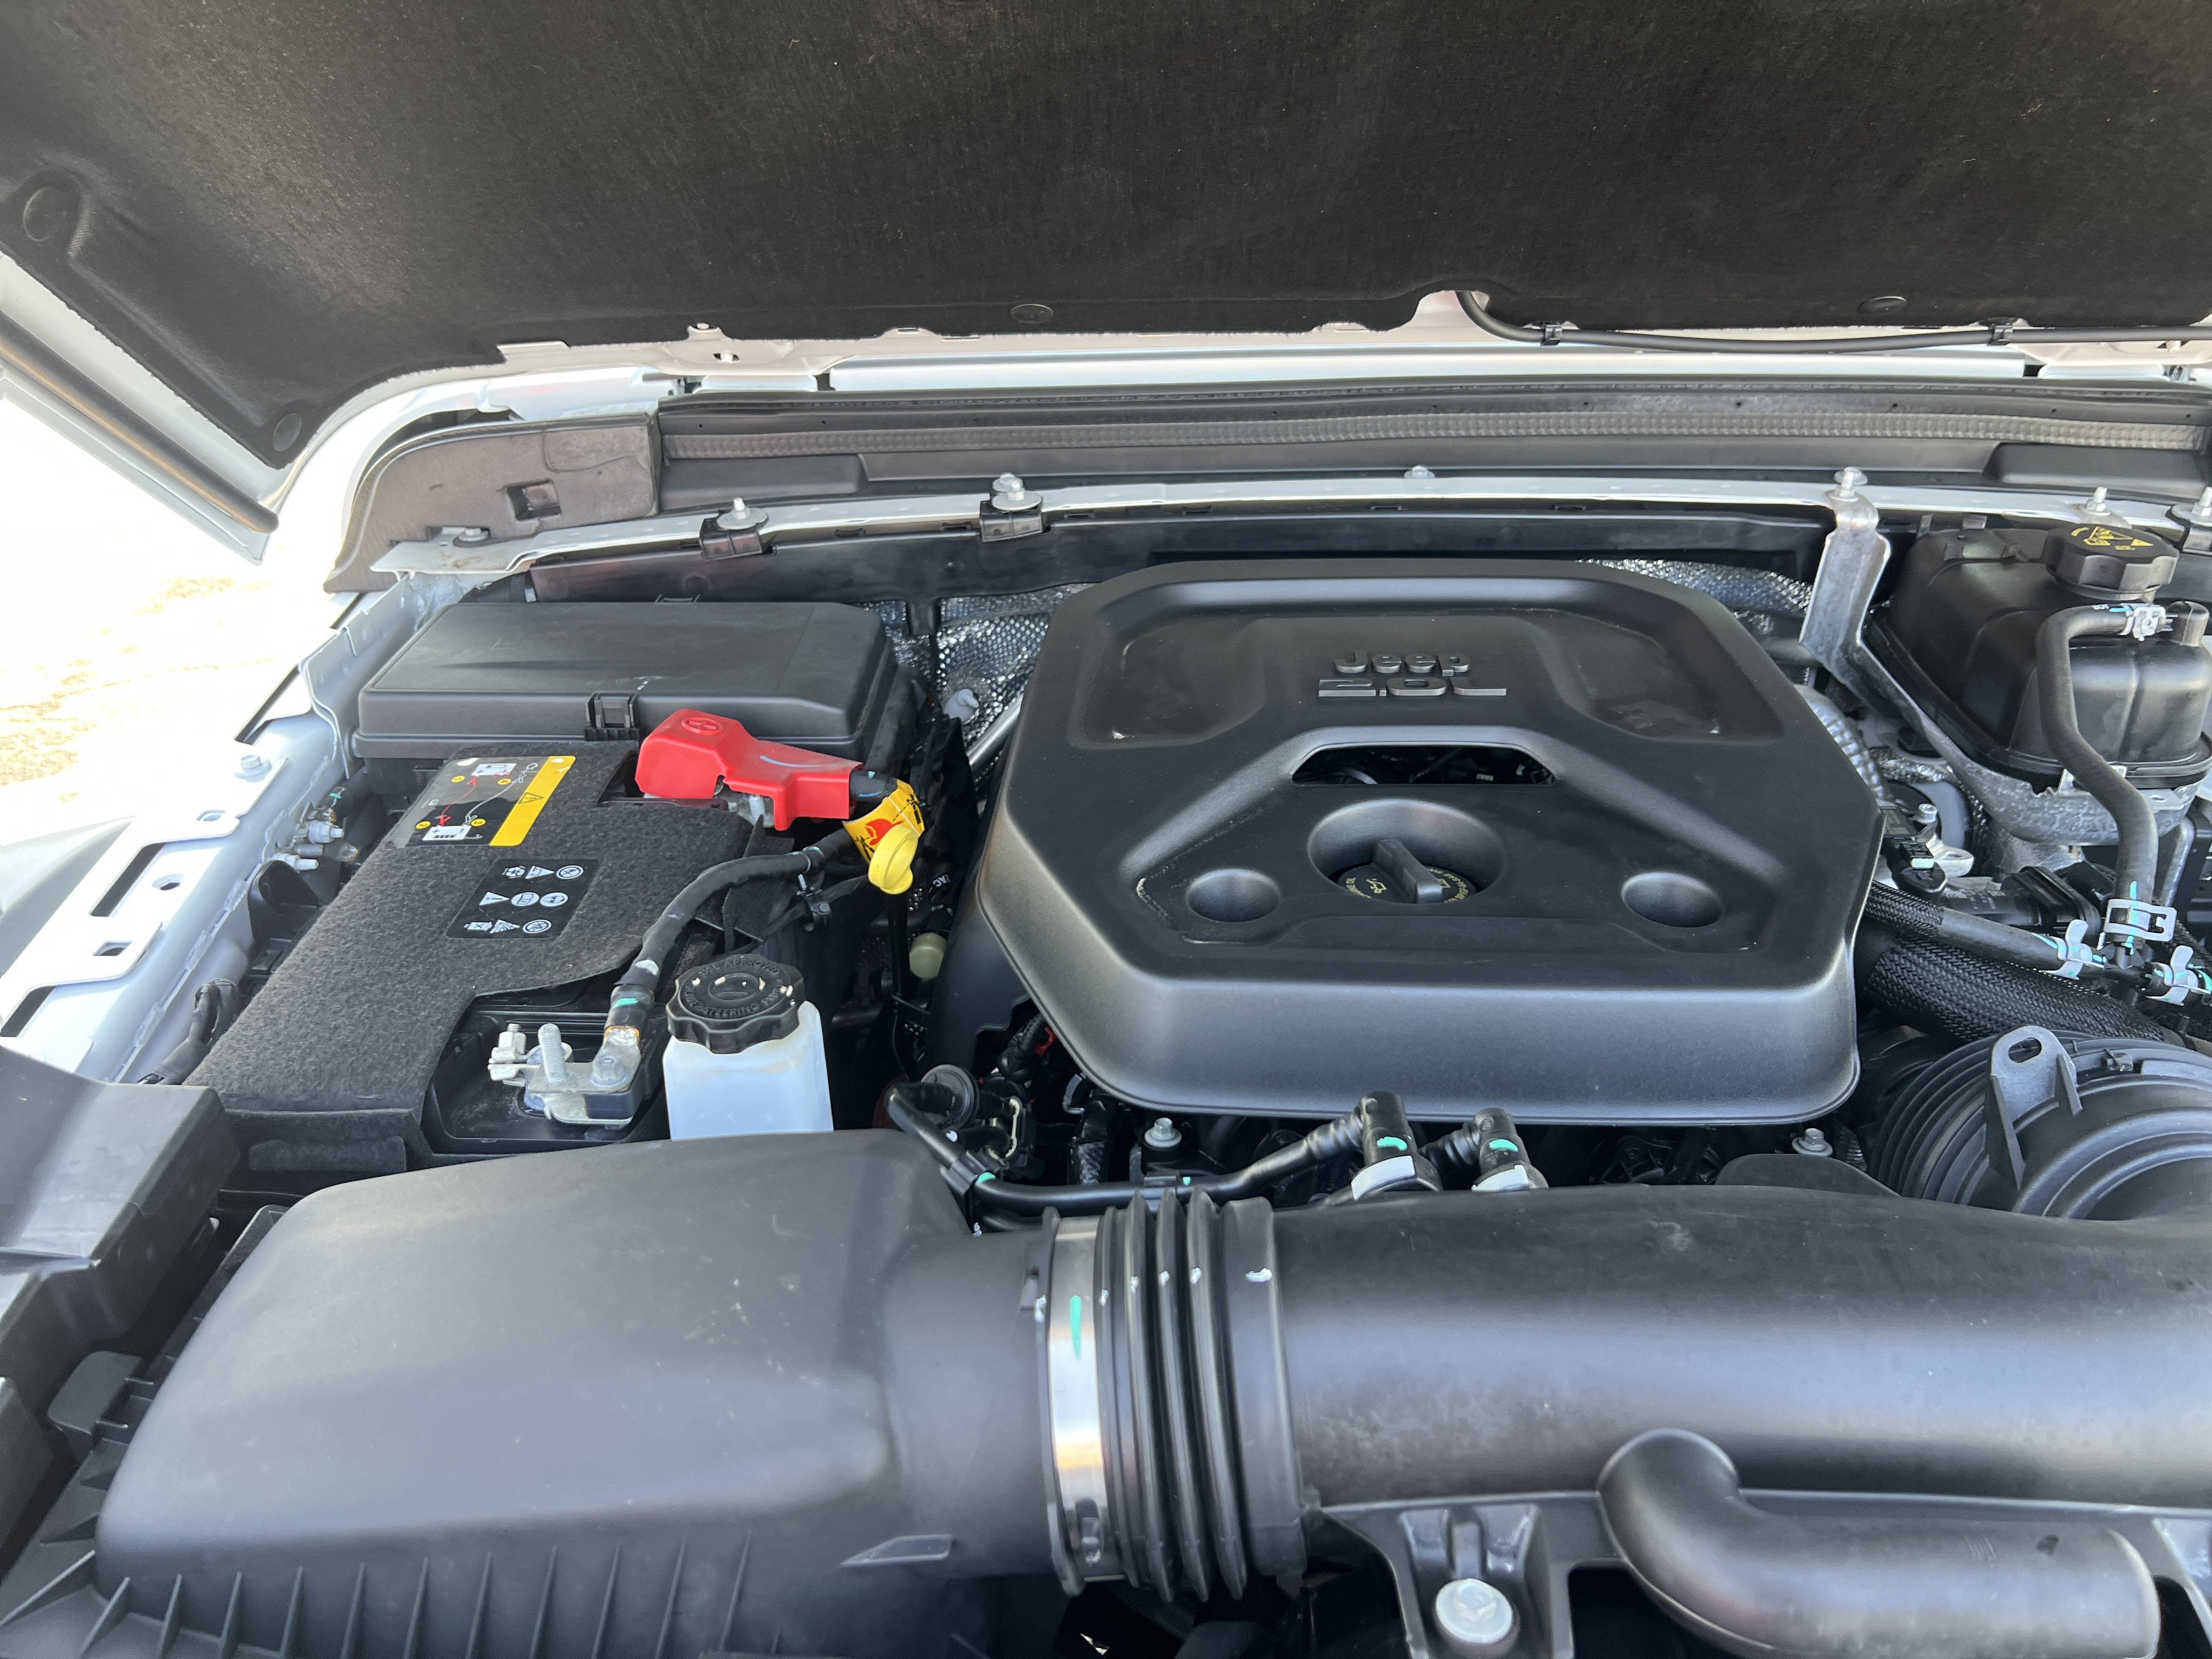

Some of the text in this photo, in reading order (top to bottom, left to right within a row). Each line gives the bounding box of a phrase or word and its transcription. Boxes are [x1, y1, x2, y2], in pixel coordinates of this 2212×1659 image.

[1334, 650, 1471, 676] Jeep
[1318, 677, 1506, 697] 2.0L
[698, 960, 781, 978] USE APPROVED
[702, 1003, 761, 1018] STEERING
